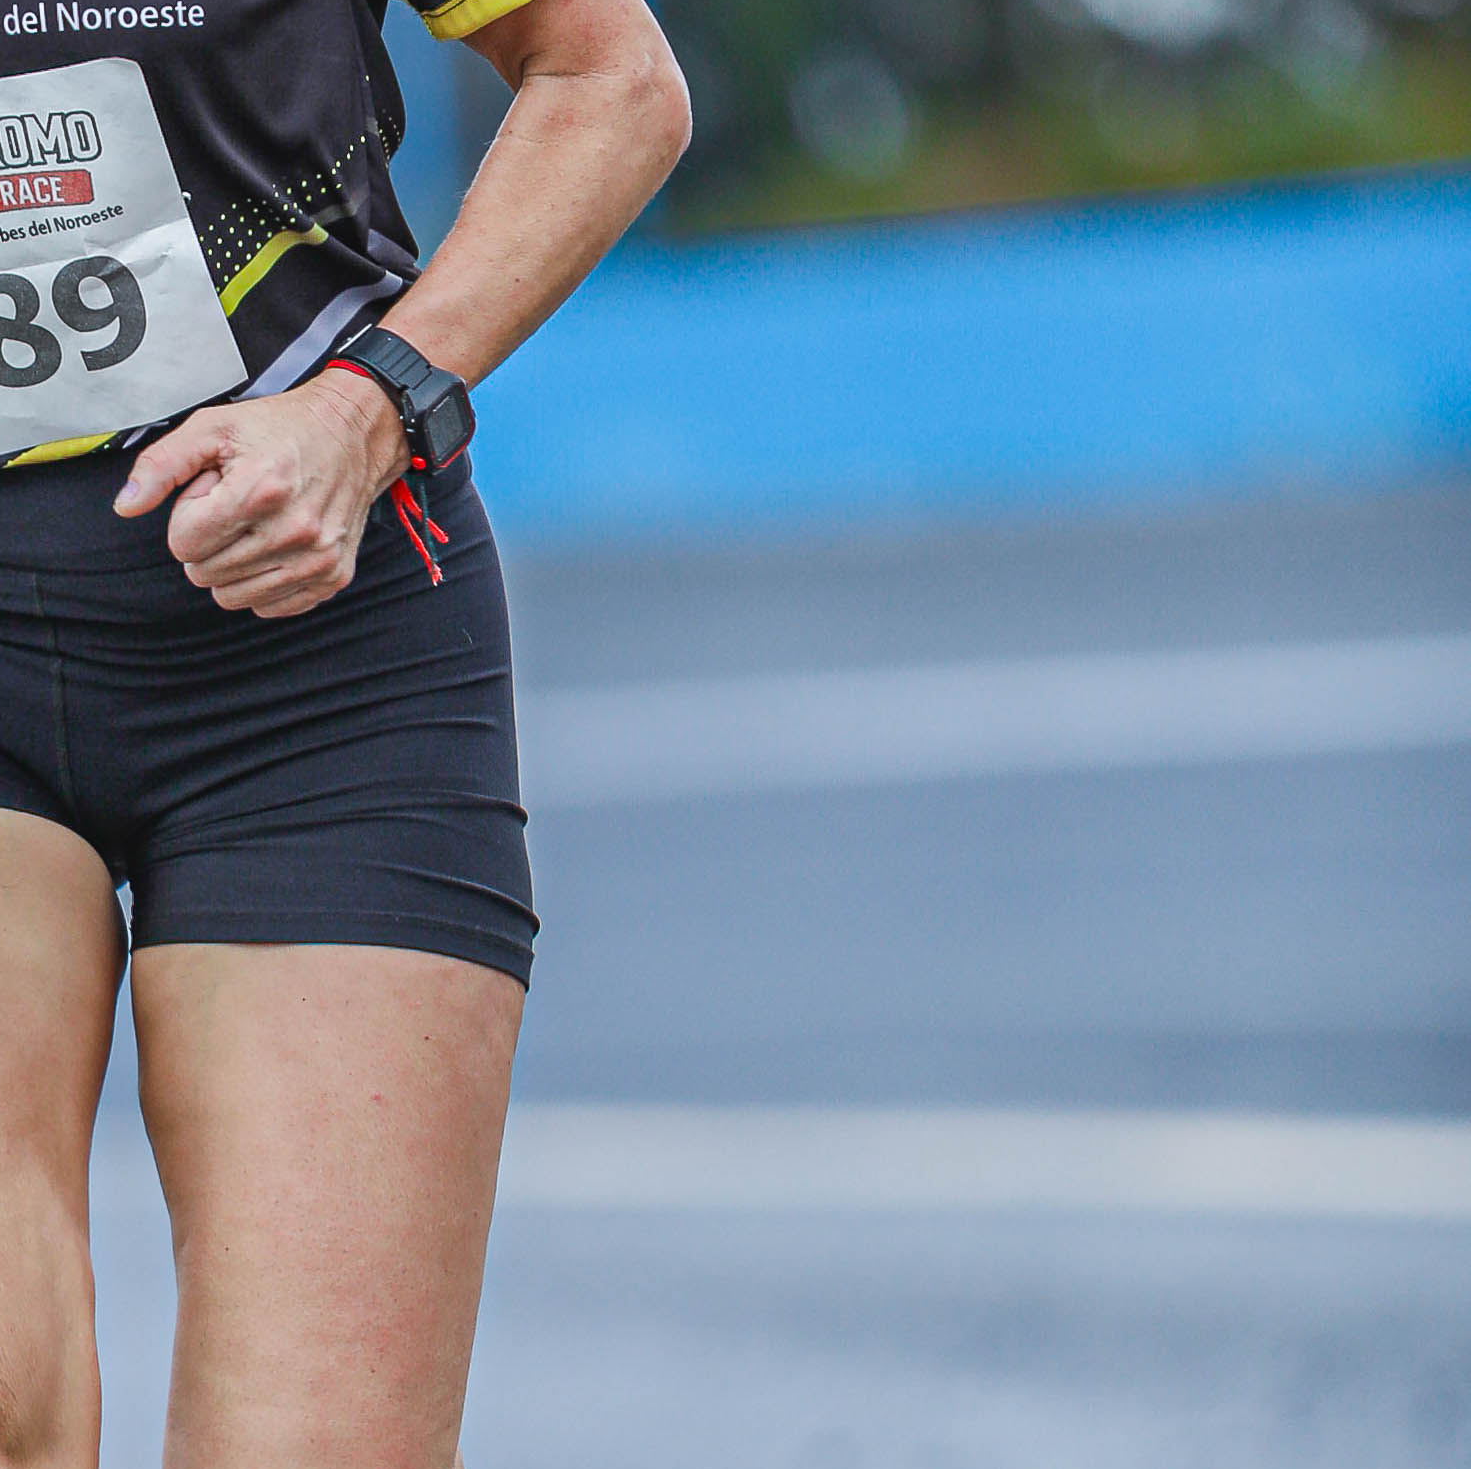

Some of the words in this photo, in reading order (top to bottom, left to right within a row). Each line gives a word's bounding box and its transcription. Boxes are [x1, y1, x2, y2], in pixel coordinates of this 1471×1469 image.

[3, 2, 47, 35] del
[56, 0, 205, 32] Noroeste
[1, 175, 65, 207] RACE
[28, 220, 52, 237] del
[53, 203, 124, 233] Noroeste
